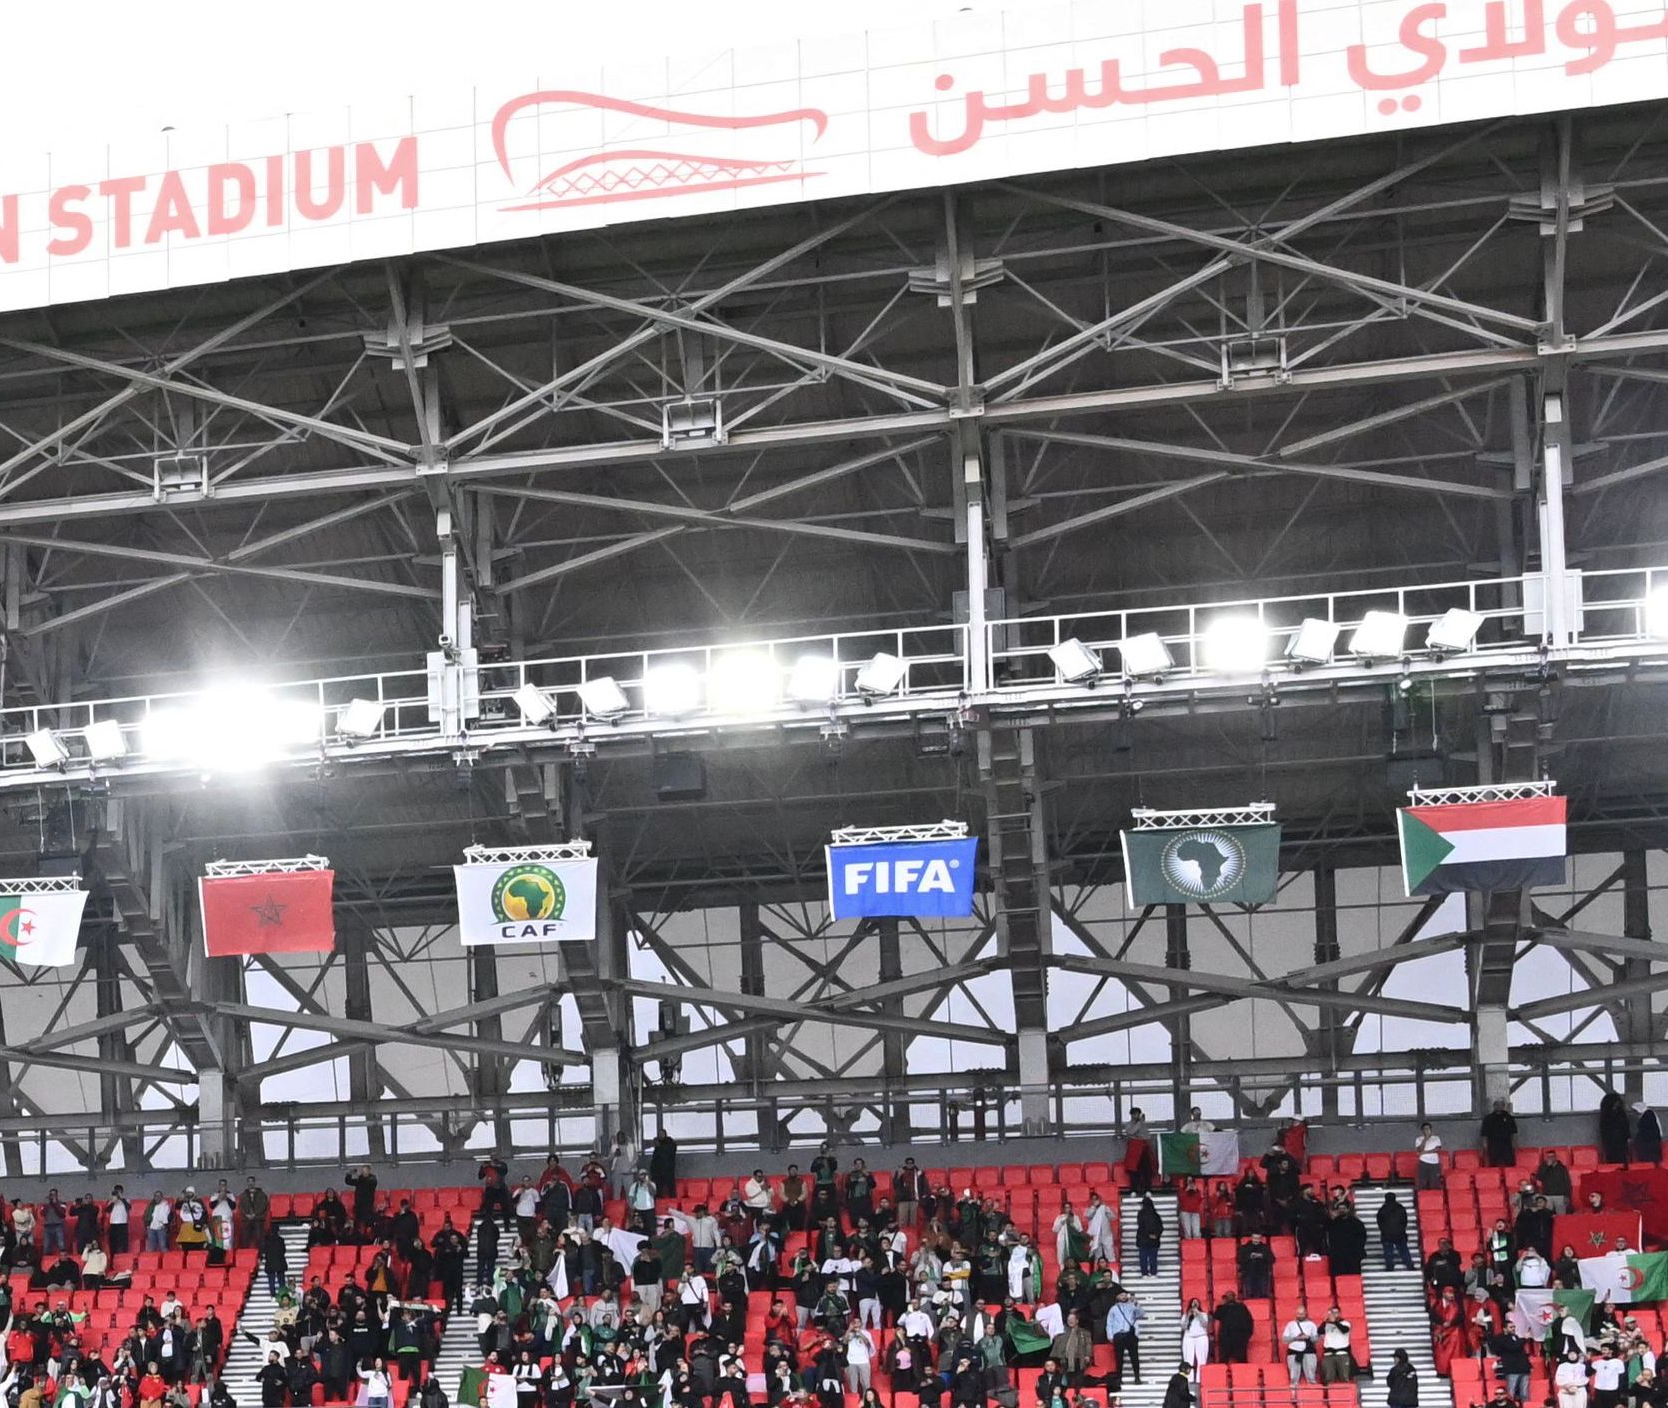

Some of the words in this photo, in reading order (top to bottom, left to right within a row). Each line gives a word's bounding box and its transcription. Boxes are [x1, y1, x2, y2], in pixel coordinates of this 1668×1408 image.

[909, 0, 1300, 157] الحسن
[1346, 0, 1668, 116] ولاي
[47, 136, 419, 256] STADIUM
[501, 924, 557, 938] CAF
[844, 859, 956, 895] FIFA
